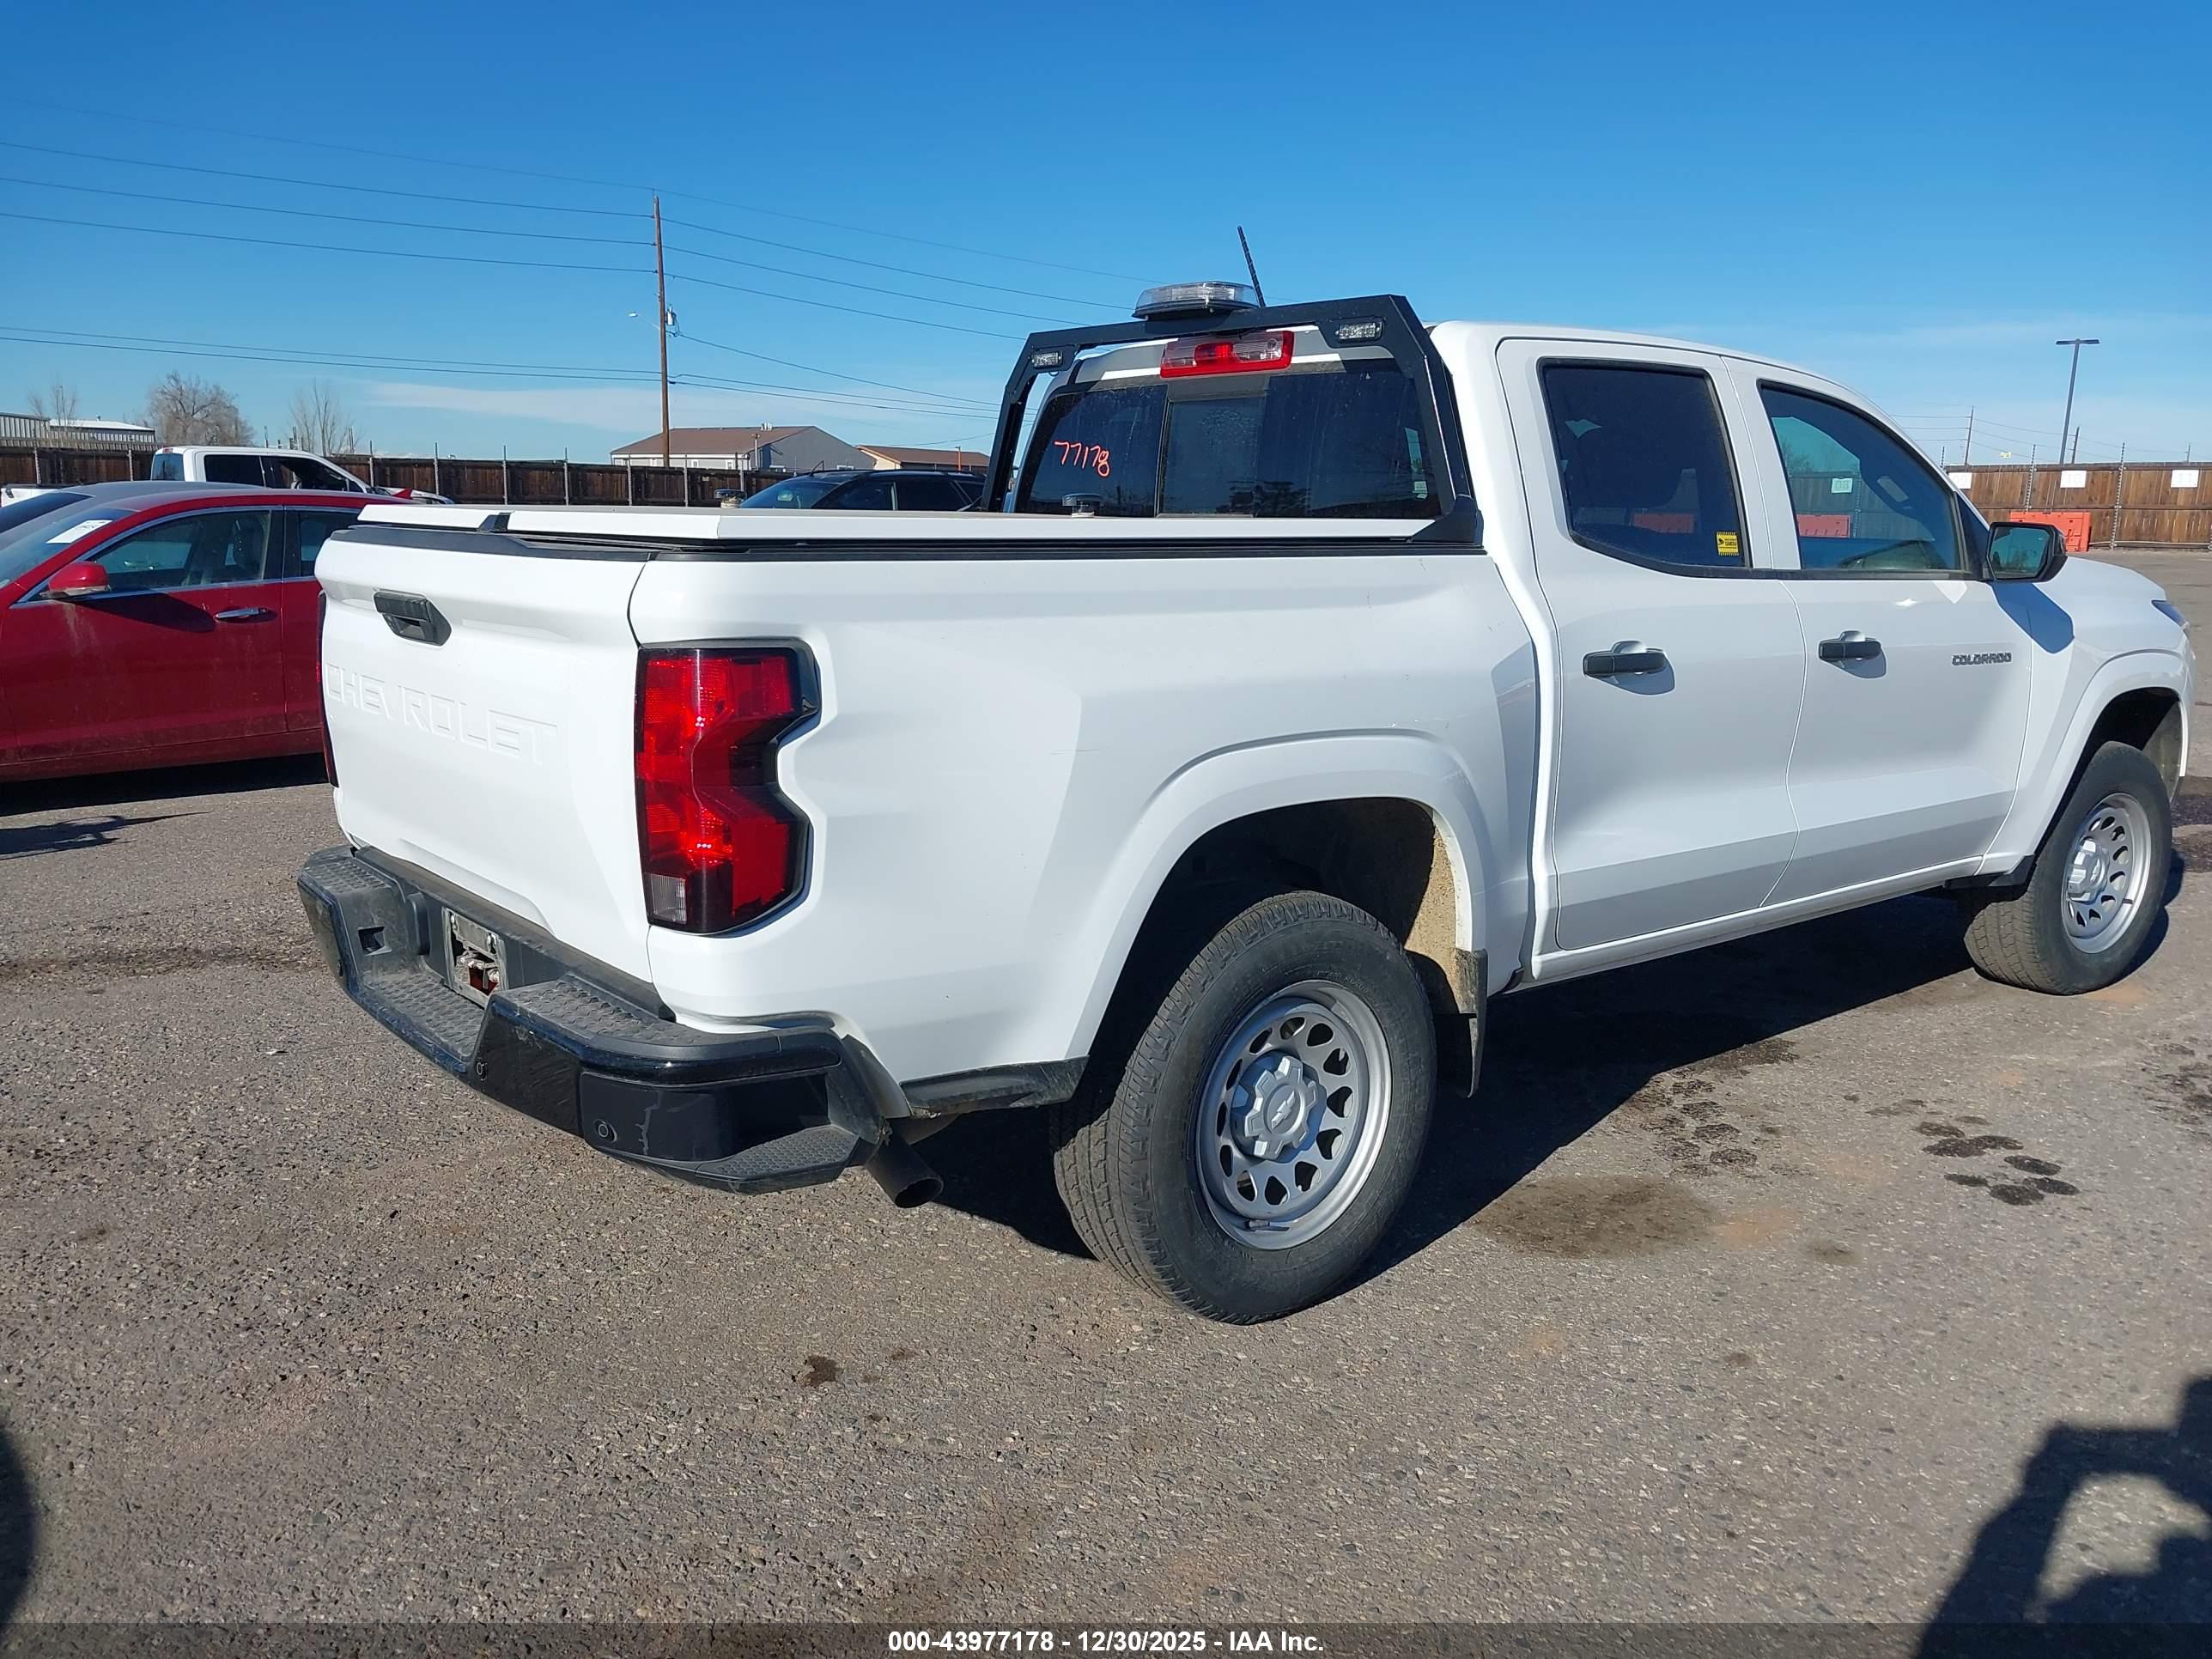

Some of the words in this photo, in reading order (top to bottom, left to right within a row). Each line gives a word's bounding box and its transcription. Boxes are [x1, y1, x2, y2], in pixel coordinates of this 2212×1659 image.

[1054, 440, 1111, 478] 77178
[1951, 652, 2013, 666] COLORADO
[325, 661, 558, 766] CHEVROLET
